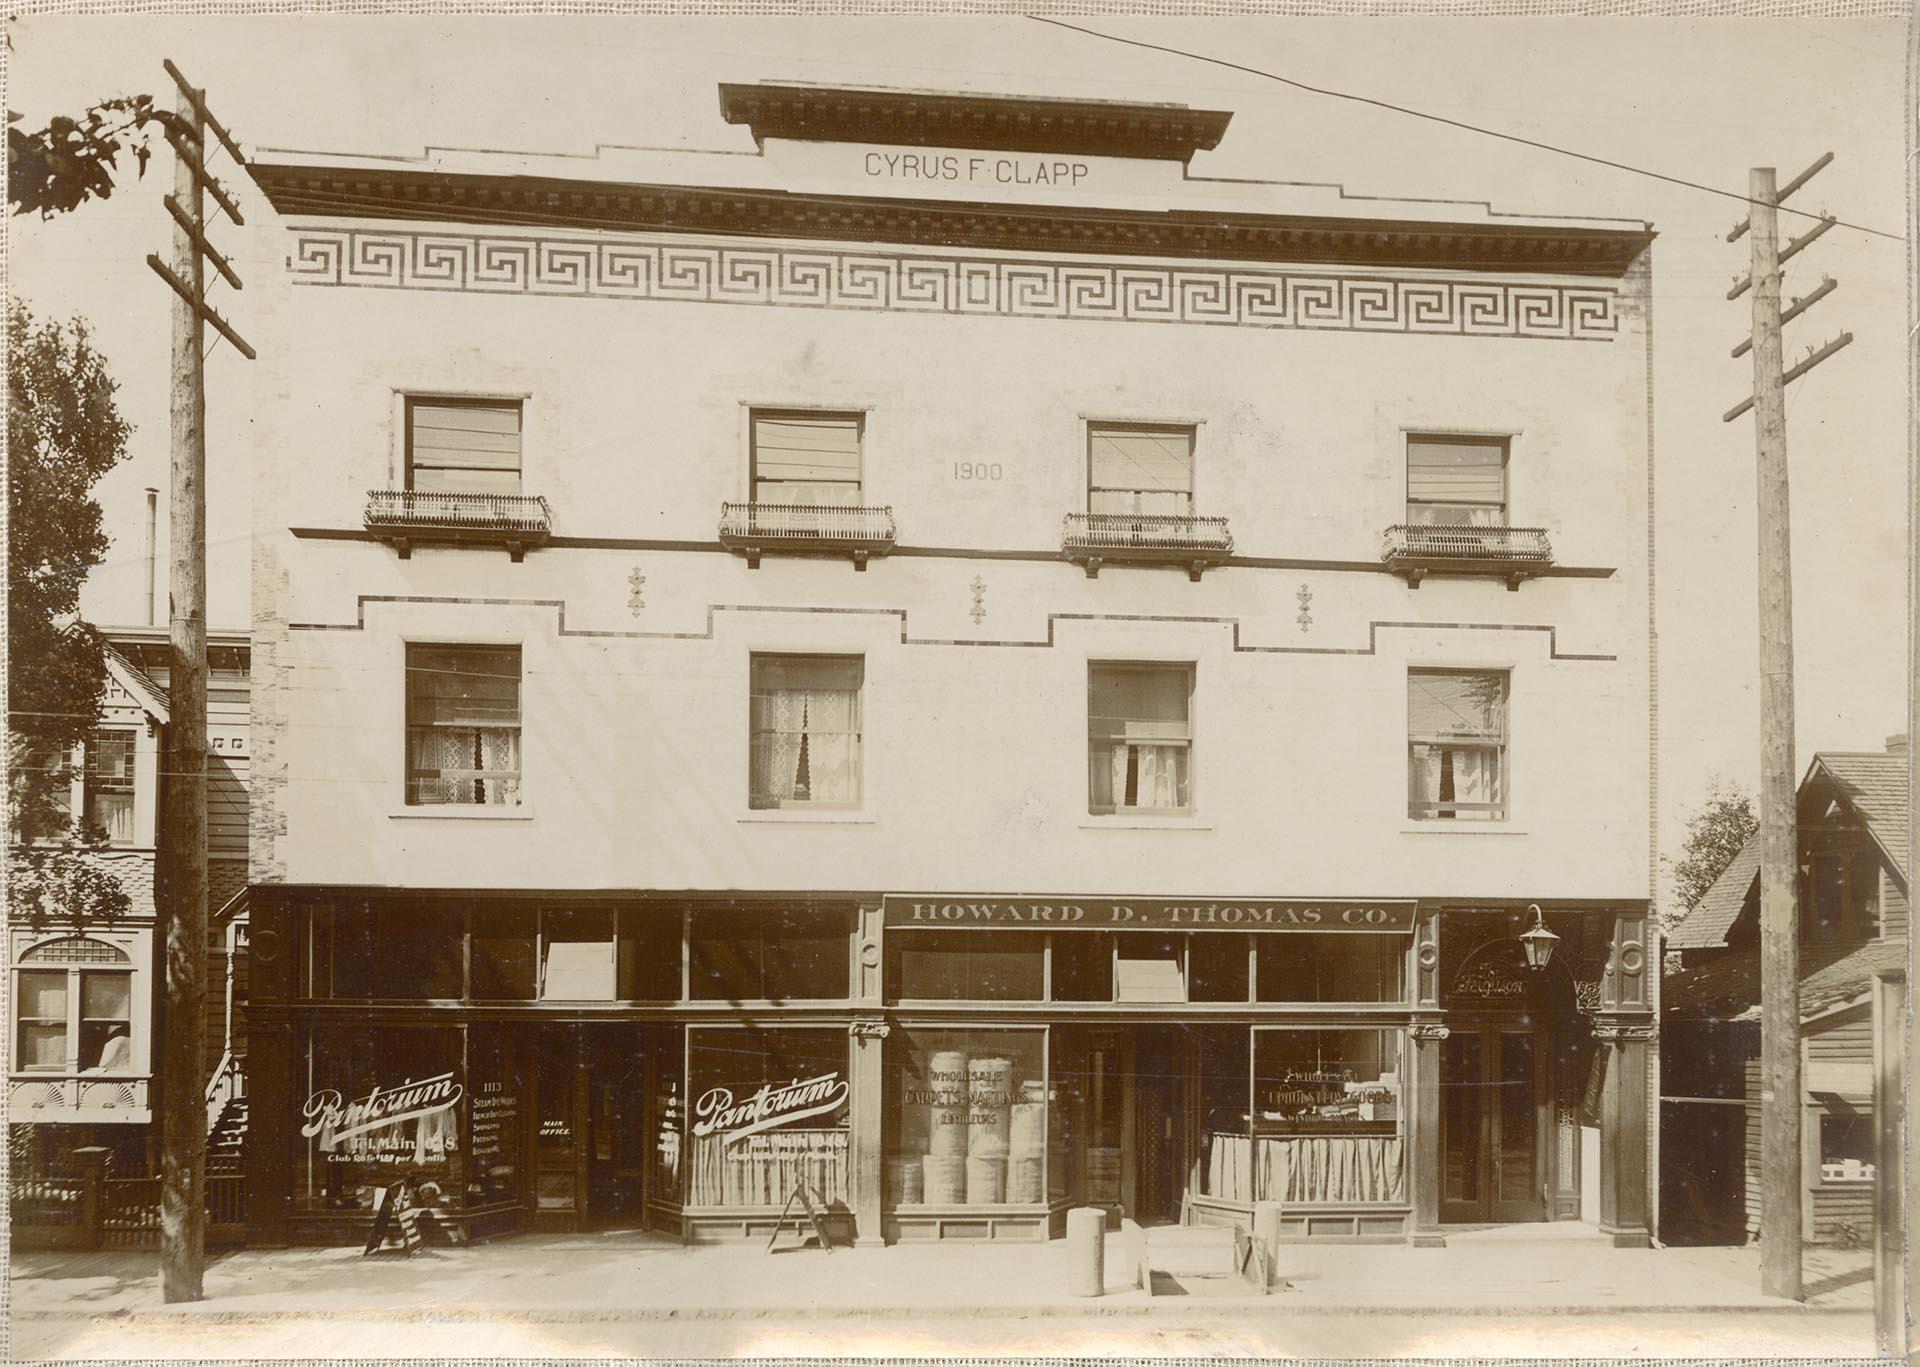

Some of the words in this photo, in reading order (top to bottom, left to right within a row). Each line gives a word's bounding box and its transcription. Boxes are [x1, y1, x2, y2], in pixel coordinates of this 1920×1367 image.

[865, 152, 958, 180] CYRUS
[995, 160, 1089, 186] CLAPP
[954, 461, 1002, 481] 1900
[911, 902, 1085, 923] HOWARD
[1111, 904, 1148, 923] D.
[1163, 903, 1322, 924] THOMAS
[1341, 907, 1397, 924] CO.
[301, 1071, 463, 1145] Pantorium
[692, 1071, 849, 1146] Pantorium
